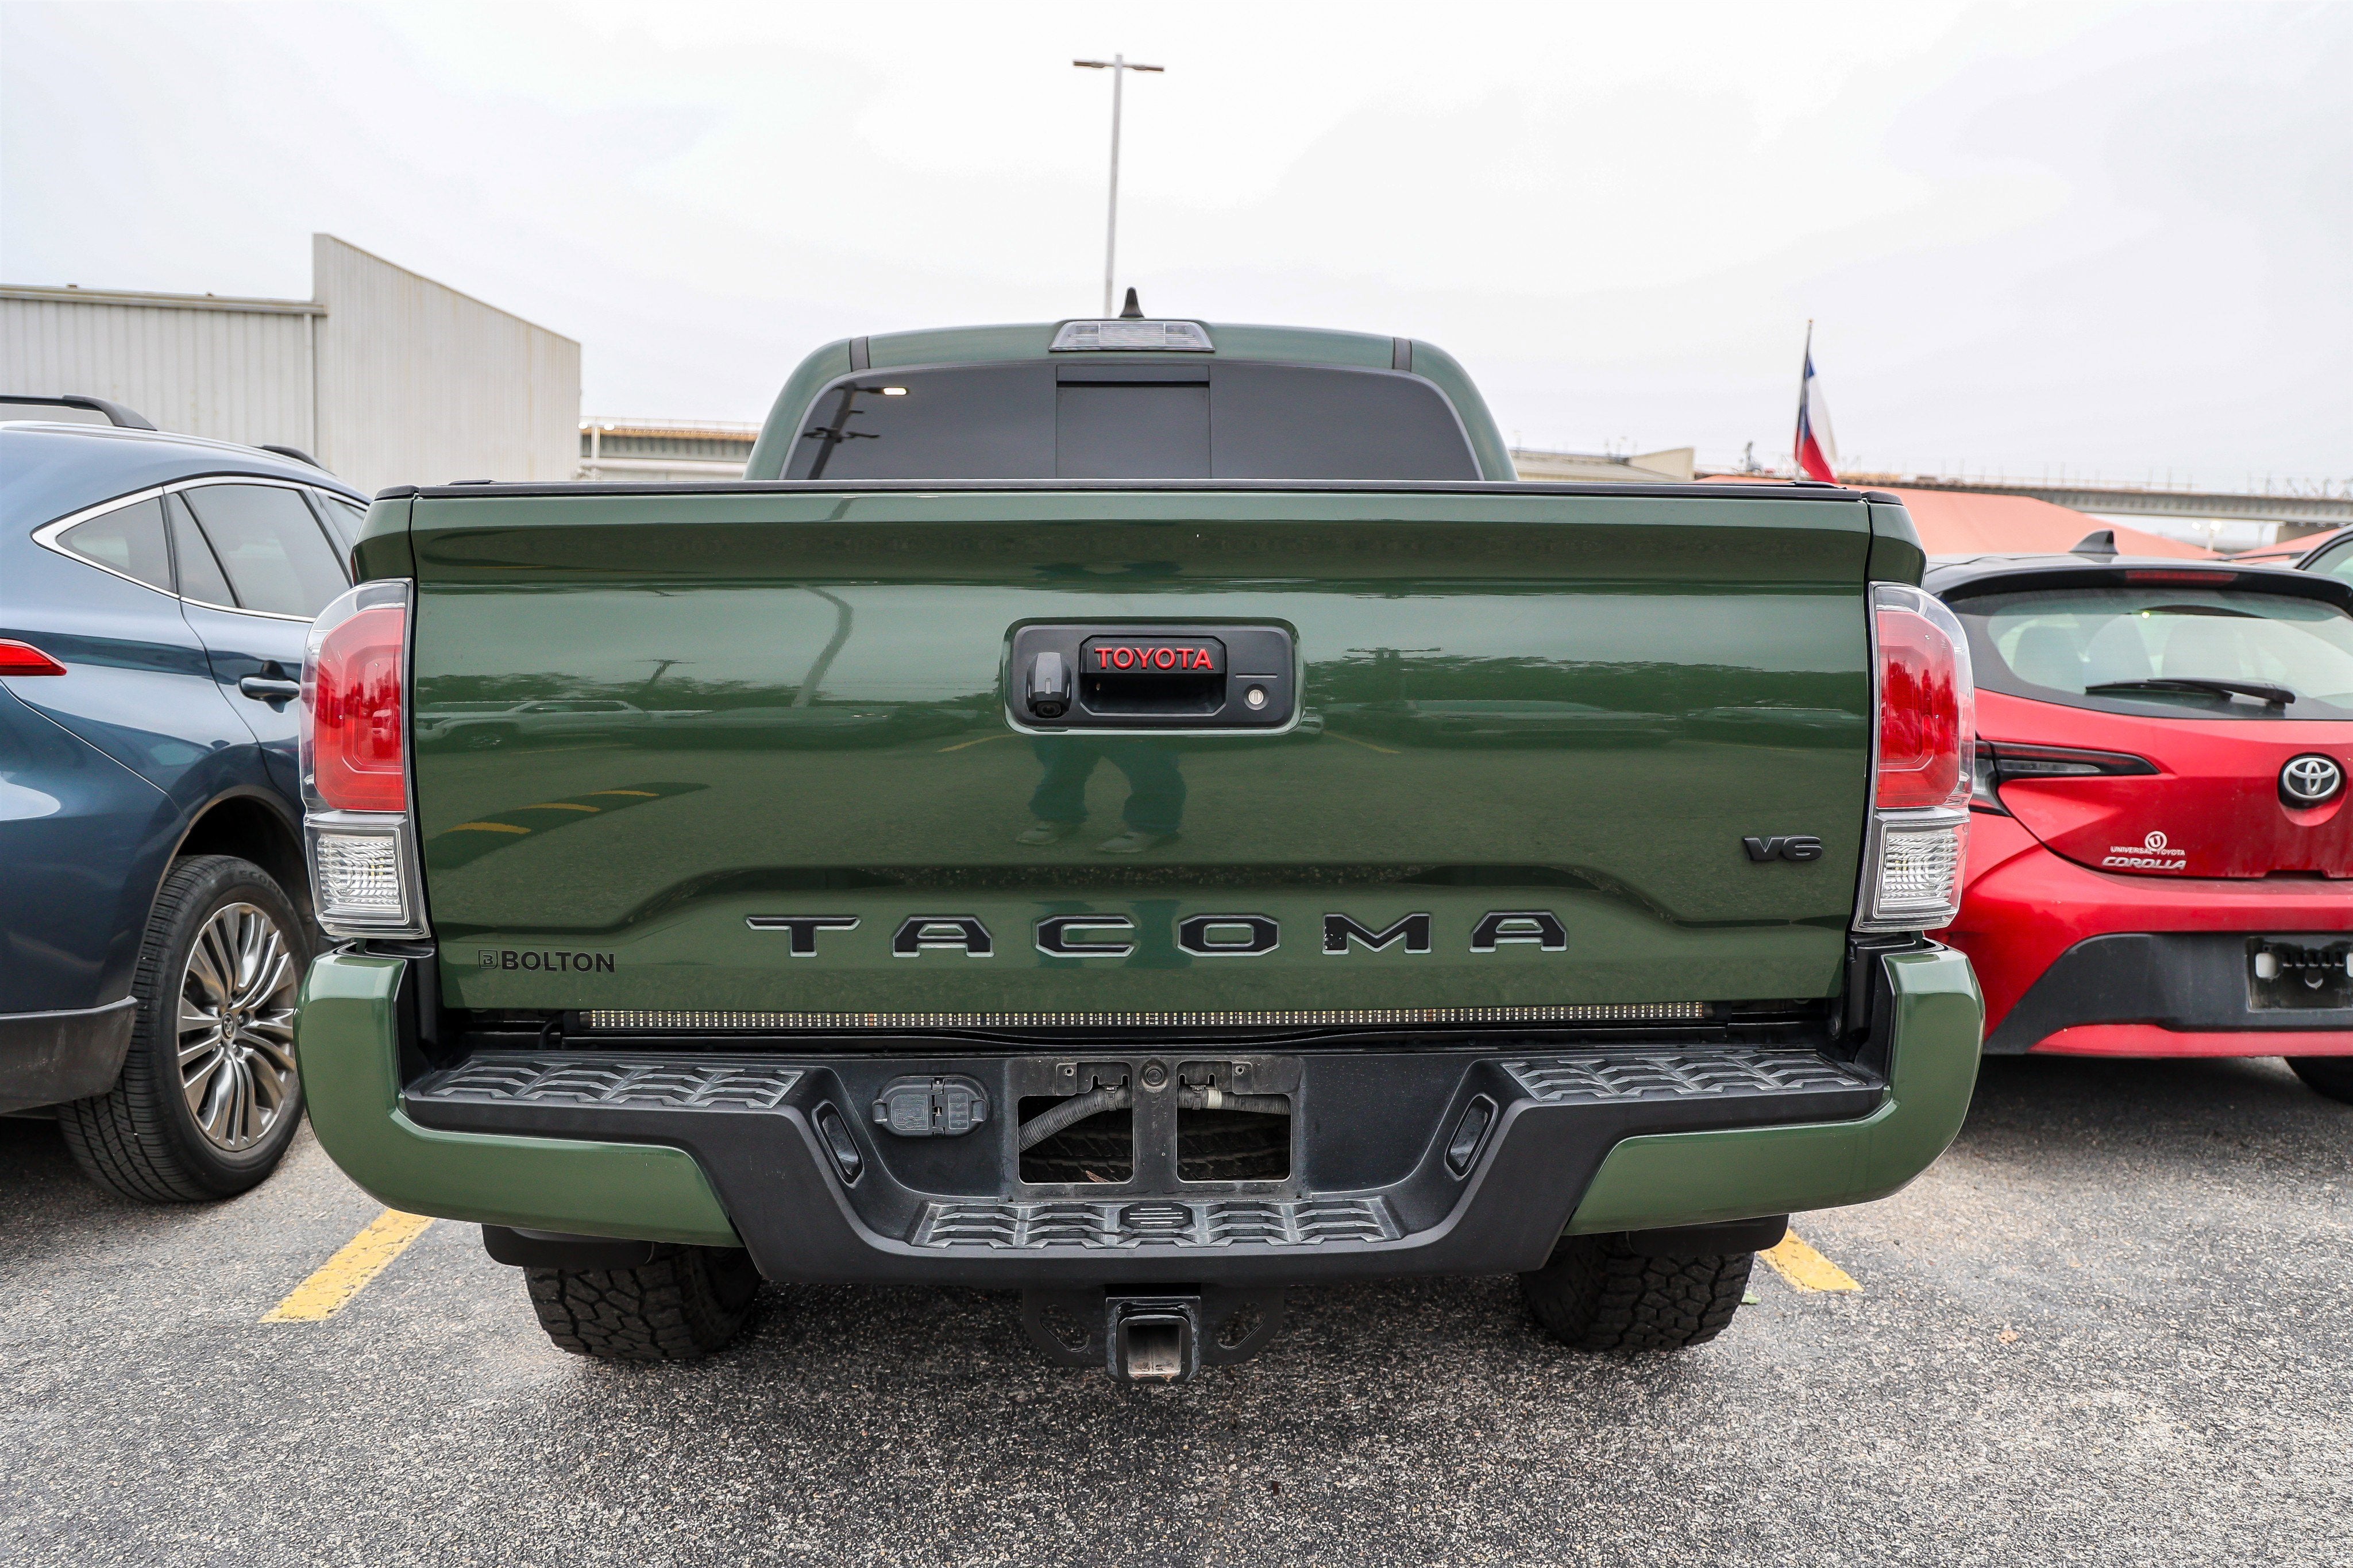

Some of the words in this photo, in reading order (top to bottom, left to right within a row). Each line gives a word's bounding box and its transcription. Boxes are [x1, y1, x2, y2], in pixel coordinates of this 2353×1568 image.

[1094, 647, 1214, 670] TOYOTA
[1743, 835, 1823, 862] V6
[2111, 847, 2154, 855] UNIVERSAL
[2103, 856, 2186, 870] COROLLA
[746, 912, 1569, 957] TACOMA
[501, 949, 615, 973] BOLTON
